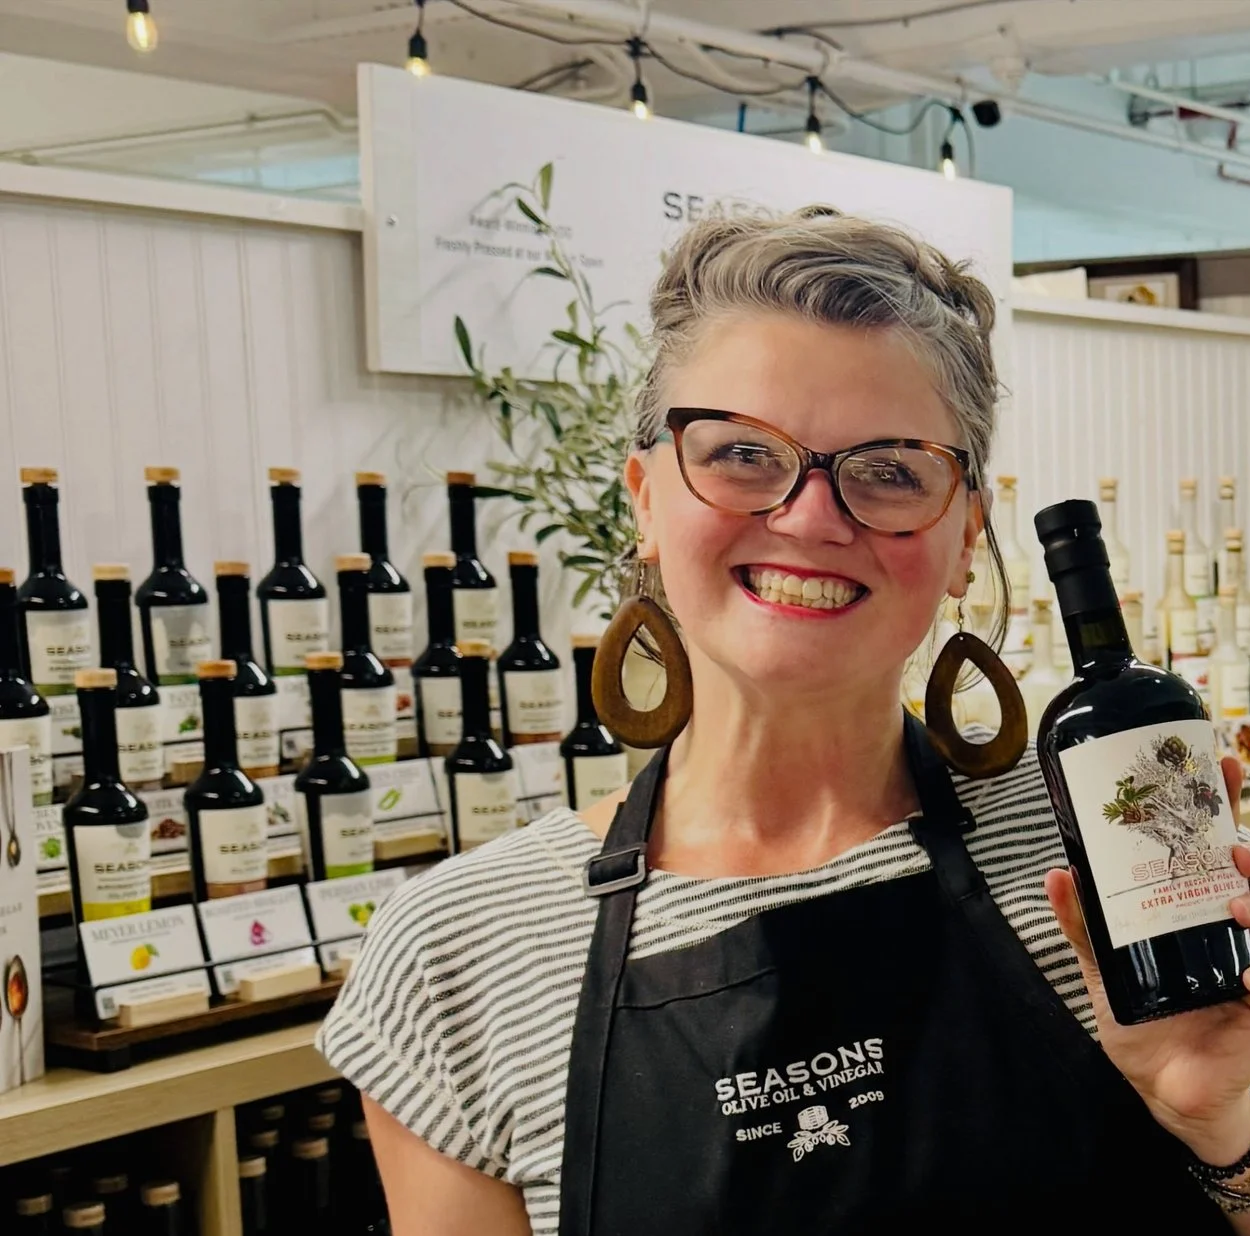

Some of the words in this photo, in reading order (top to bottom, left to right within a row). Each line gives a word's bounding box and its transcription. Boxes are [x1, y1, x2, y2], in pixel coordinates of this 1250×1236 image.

[1131, 844, 1233, 881] SEASON
[1141, 895, 1174, 910] EXTRA
[1177, 886, 1211, 901] VIRGIN
[1213, 881, 1236, 894] OLIVE
[714, 1038, 884, 1101] SEASONS
[721, 1092, 771, 1116] OLIVE
[772, 1087, 800, 1105] OIL
[802, 1083, 817, 1097] &
[816, 1061, 884, 1092] VINEGAR
[735, 1122, 783, 1142] SINCE
[848, 1090, 885, 1110] 2009
